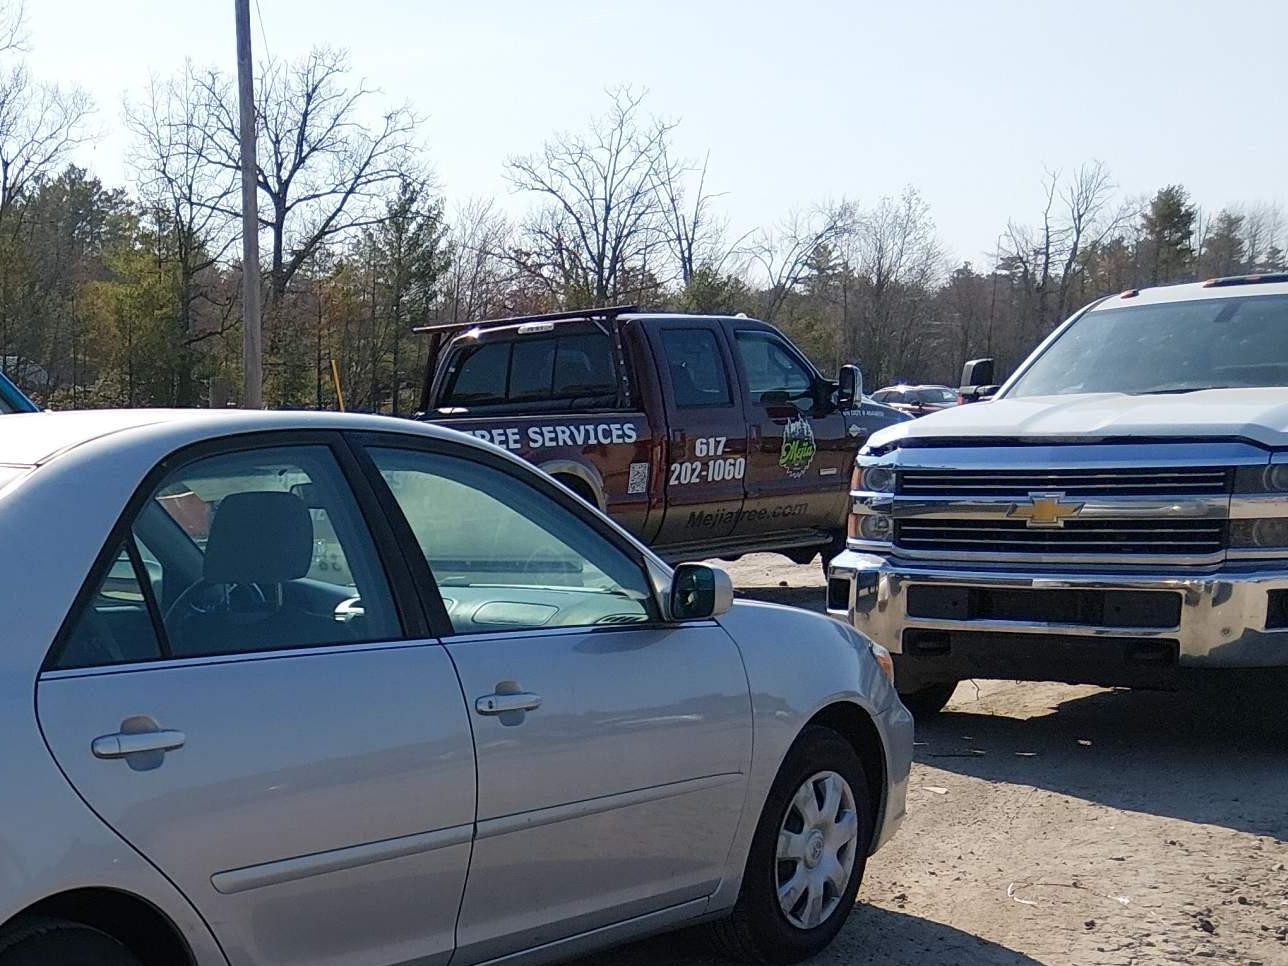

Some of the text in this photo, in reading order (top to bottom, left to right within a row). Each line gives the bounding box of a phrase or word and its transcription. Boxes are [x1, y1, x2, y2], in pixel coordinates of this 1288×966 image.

[462, 423, 637, 449] REE SERVICES
[669, 458, 746, 485] 202-1060
